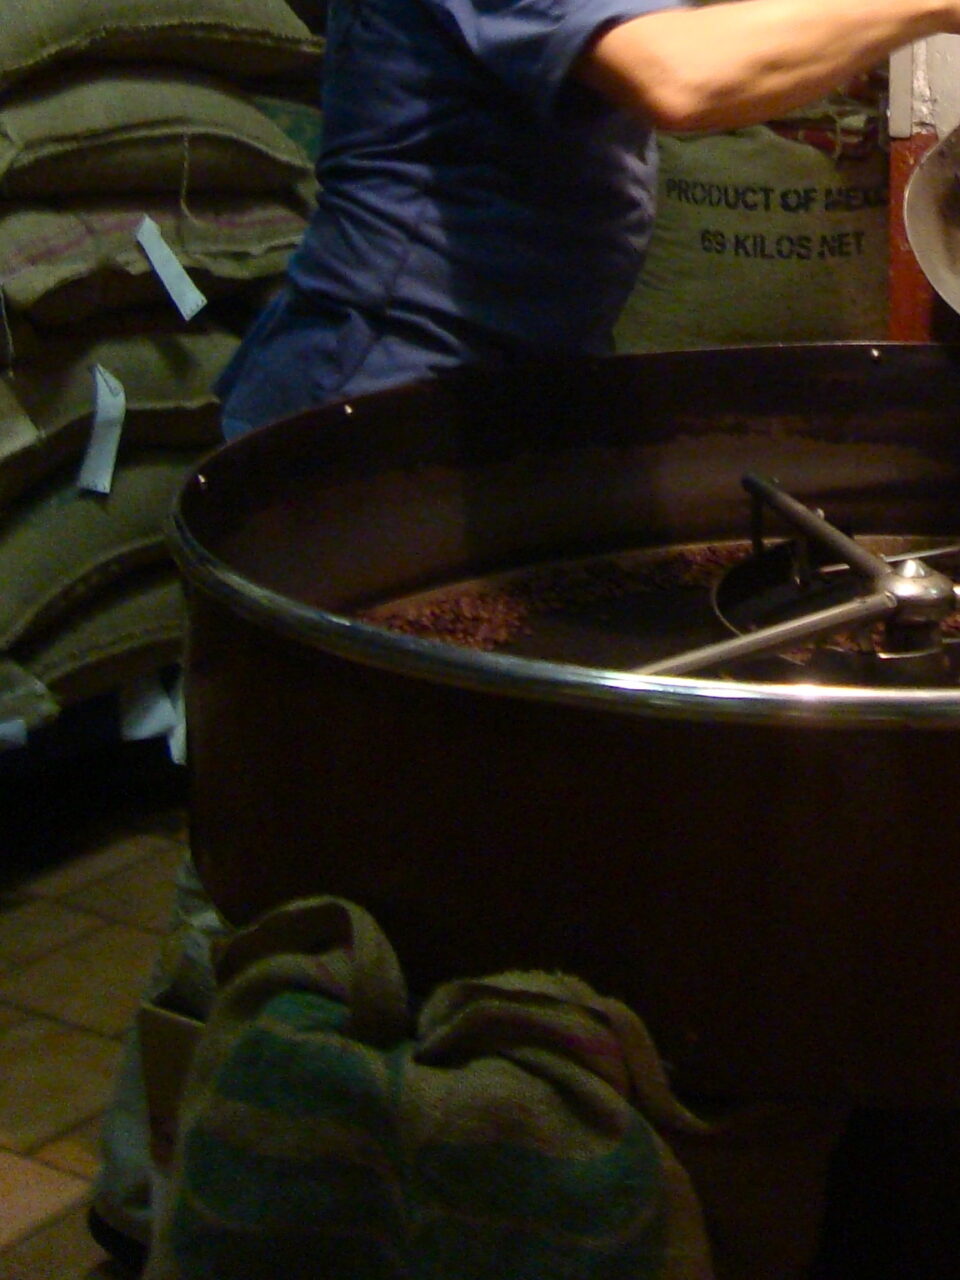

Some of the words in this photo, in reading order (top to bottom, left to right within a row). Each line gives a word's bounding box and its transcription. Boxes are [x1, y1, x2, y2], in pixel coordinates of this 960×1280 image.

[665, 177, 775, 212] PRODUCT
[780, 188, 818, 212] OF
[733, 232, 813, 260] KILOS
[817, 230, 865, 260] NET
